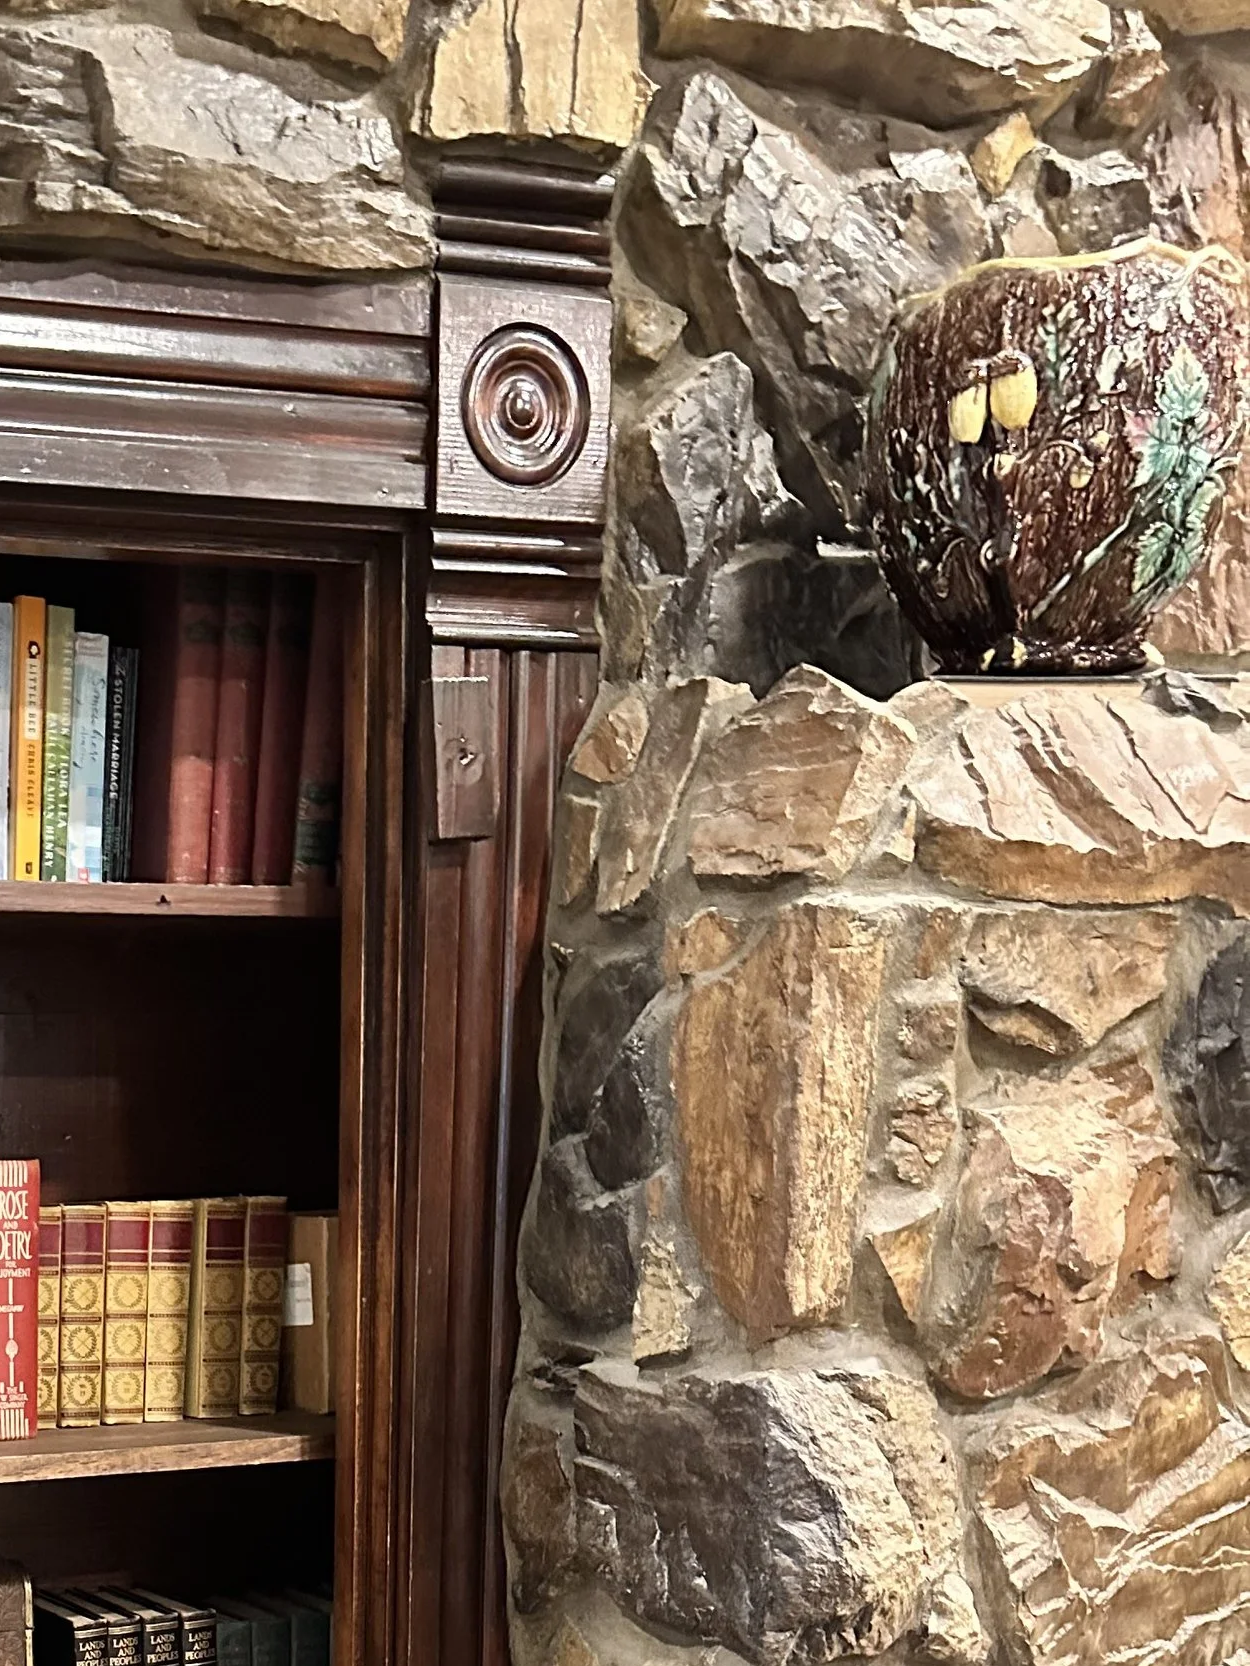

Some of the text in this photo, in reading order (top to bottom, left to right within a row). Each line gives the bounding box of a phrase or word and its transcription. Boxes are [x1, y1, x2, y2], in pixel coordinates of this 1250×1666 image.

[27, 663, 37, 734] LITTLE BEE
[112, 679, 123, 730] STOLEN
[27, 743, 36, 777] CHRIS
[109, 732, 121, 800] MARRIAGE
[56, 803, 68, 828] LEA
[44, 824, 56, 868] HENRY
[2, 1221, 18, 1231] AND
[5, 1260, 17, 1268] FOR
[113, 1637, 139, 1648] LANDS
[150, 1633, 175, 1645] LANDS
[188, 1631, 212, 1642] LANDS
[79, 1640, 105, 1651] LANDS
[118, 1646, 136, 1657] AND
[155, 1643, 172, 1653] AND
[193, 1641, 210, 1651] AND
[84, 1650, 102, 1660] AND
[110, 1653, 142, 1666] PEOPLES
[147, 1650, 179, 1664] PEOPLES
[185, 1648, 216, 1661] PEOPLES
